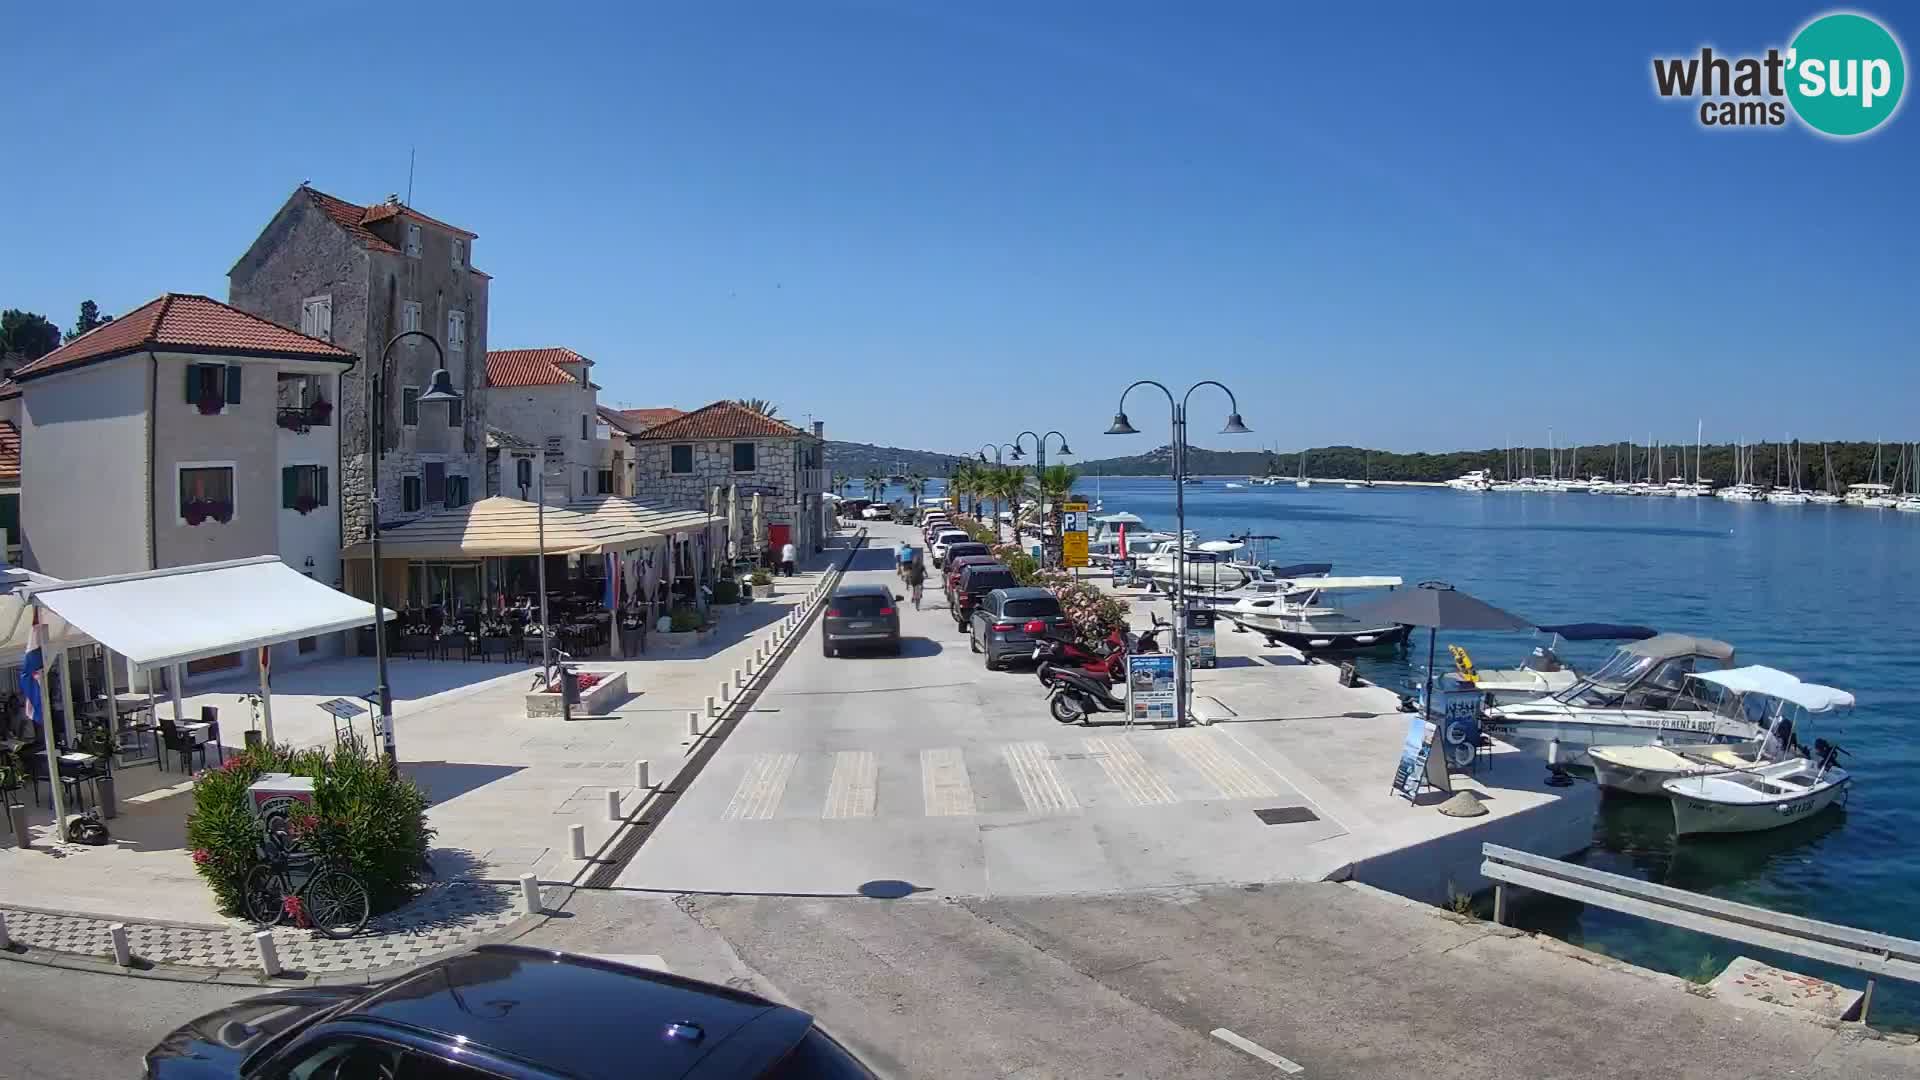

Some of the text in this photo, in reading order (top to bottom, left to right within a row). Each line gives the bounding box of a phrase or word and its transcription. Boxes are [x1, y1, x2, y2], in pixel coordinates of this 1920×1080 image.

[1064, 513, 1075, 529] P
[1671, 720, 1690, 729] RENT
[1692, 721, 1697, 729] A
[1698, 721, 1716, 732] BOAT
